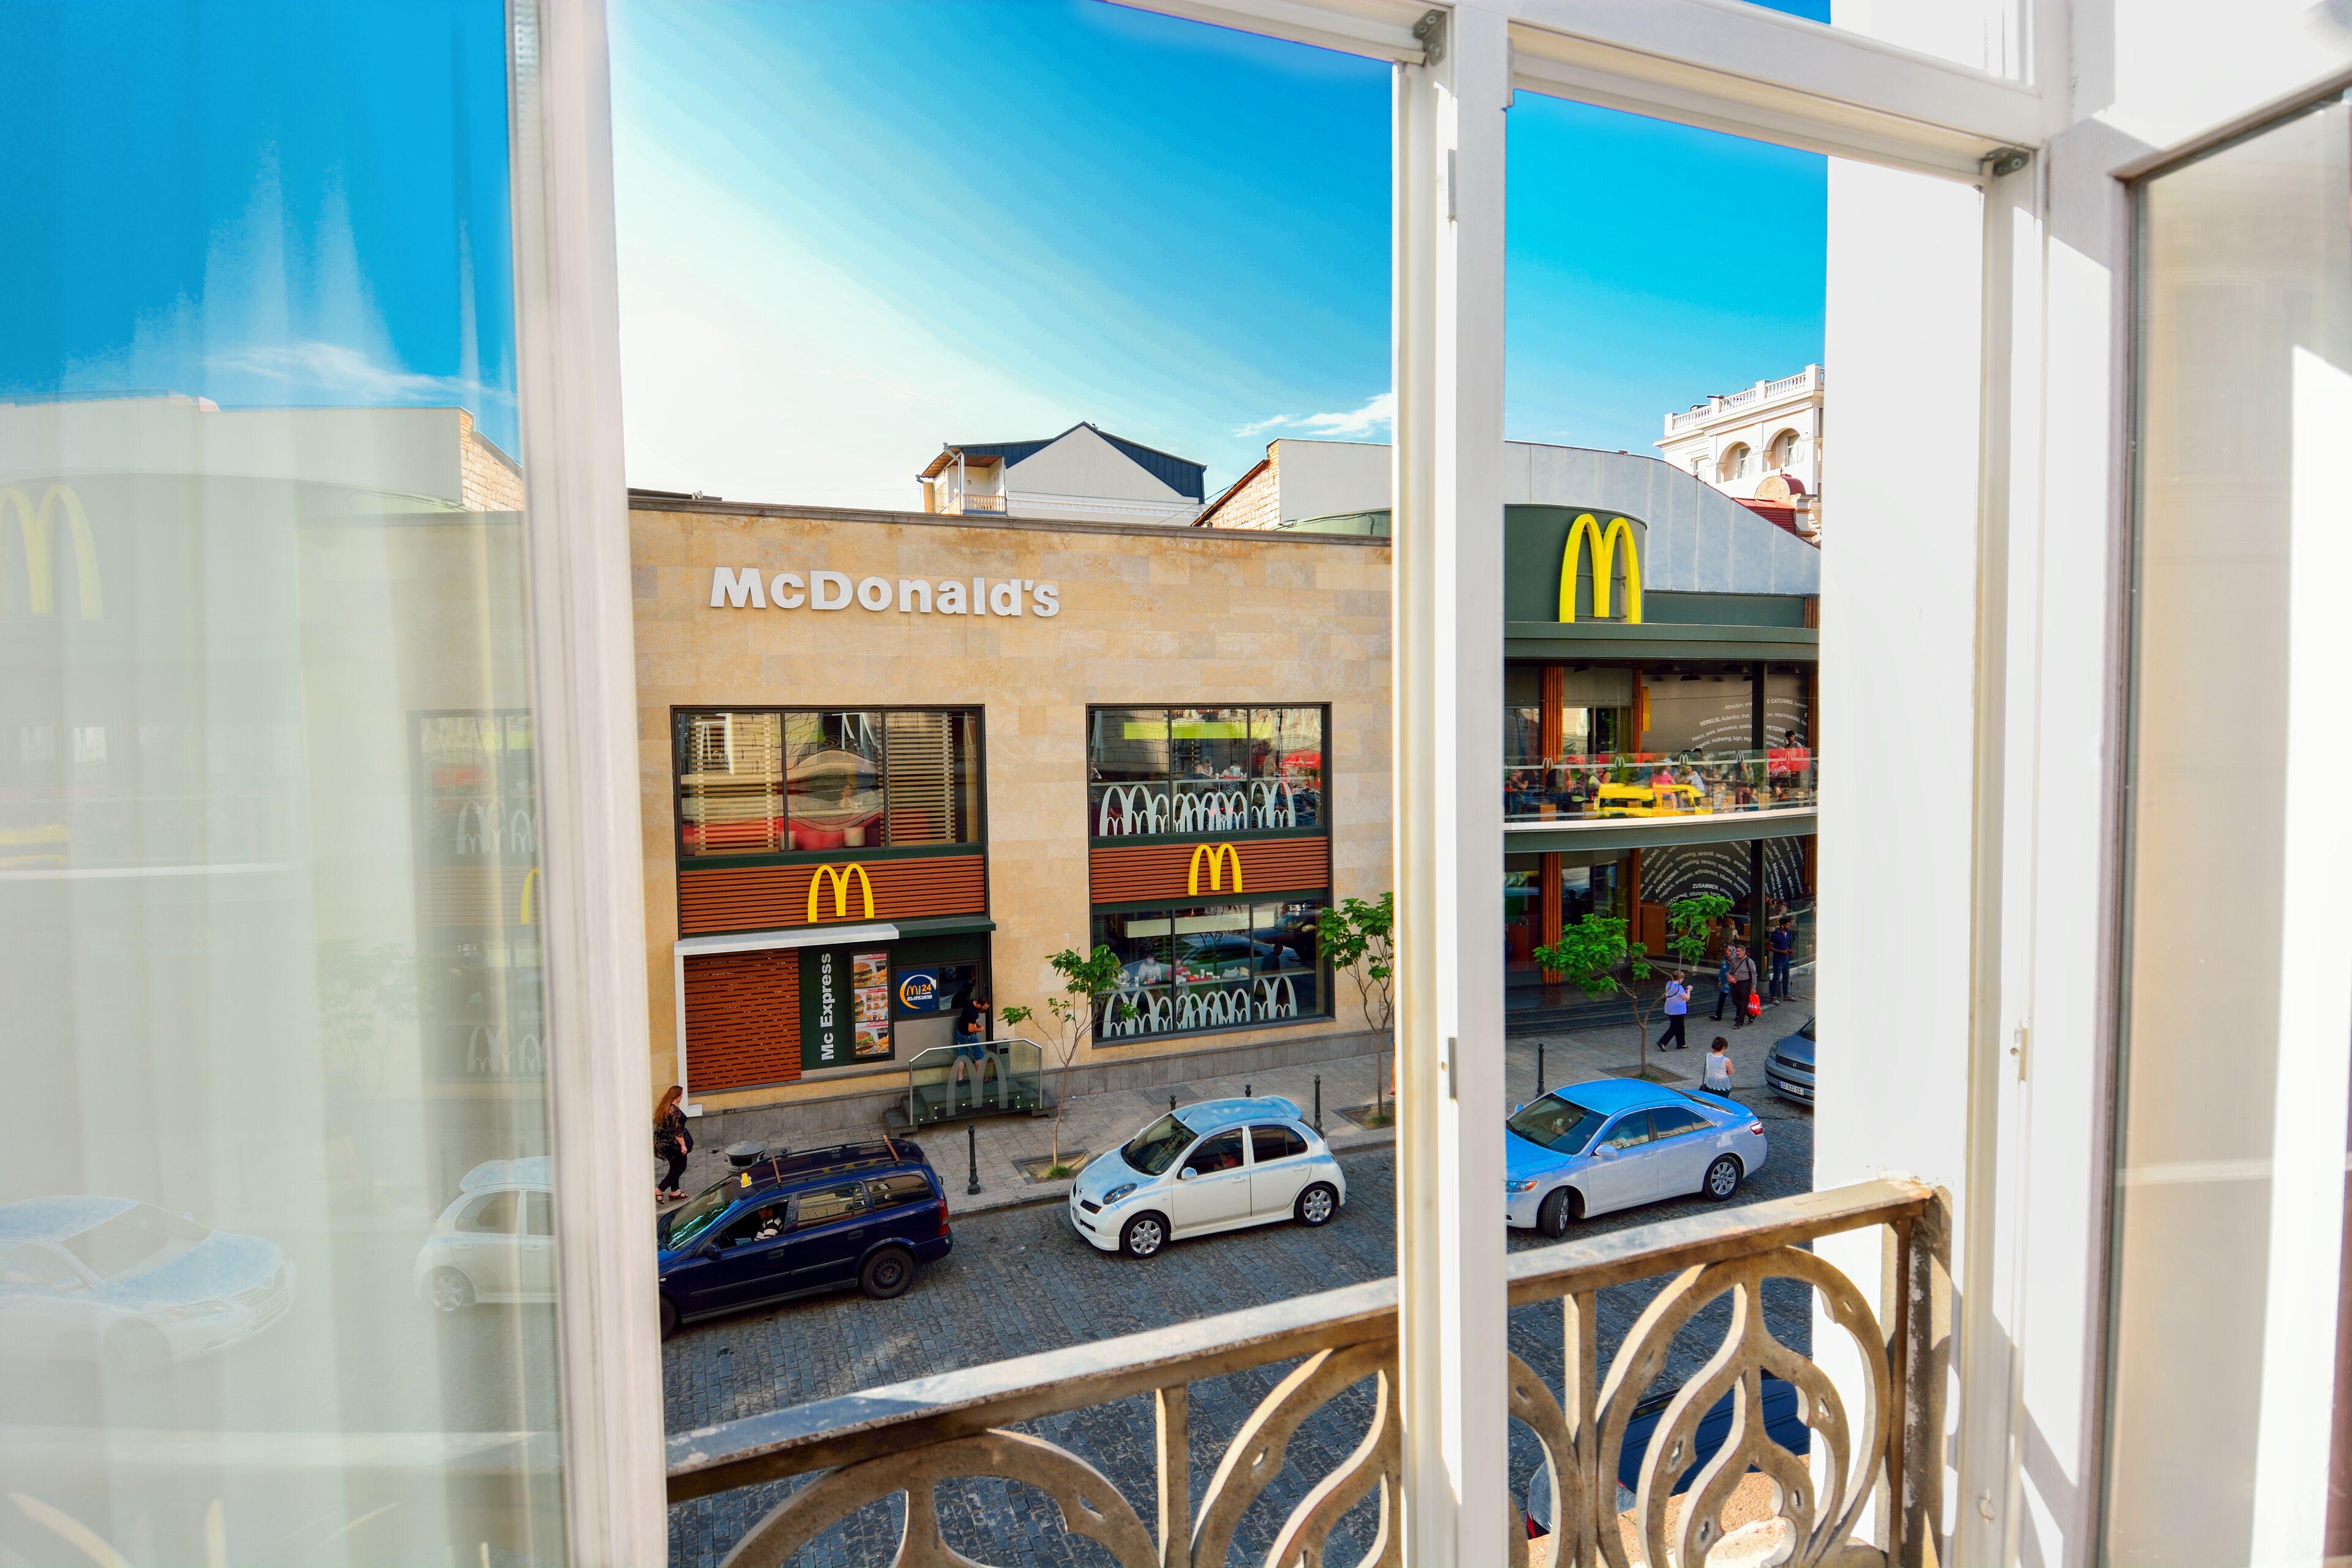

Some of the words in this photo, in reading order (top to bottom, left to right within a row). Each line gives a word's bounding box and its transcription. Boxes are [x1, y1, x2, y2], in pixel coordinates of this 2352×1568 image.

[710, 567, 1060, 617] McDonald's
[820, 952, 835, 1028] Express
[821, 1032, 834, 1061] Mc
